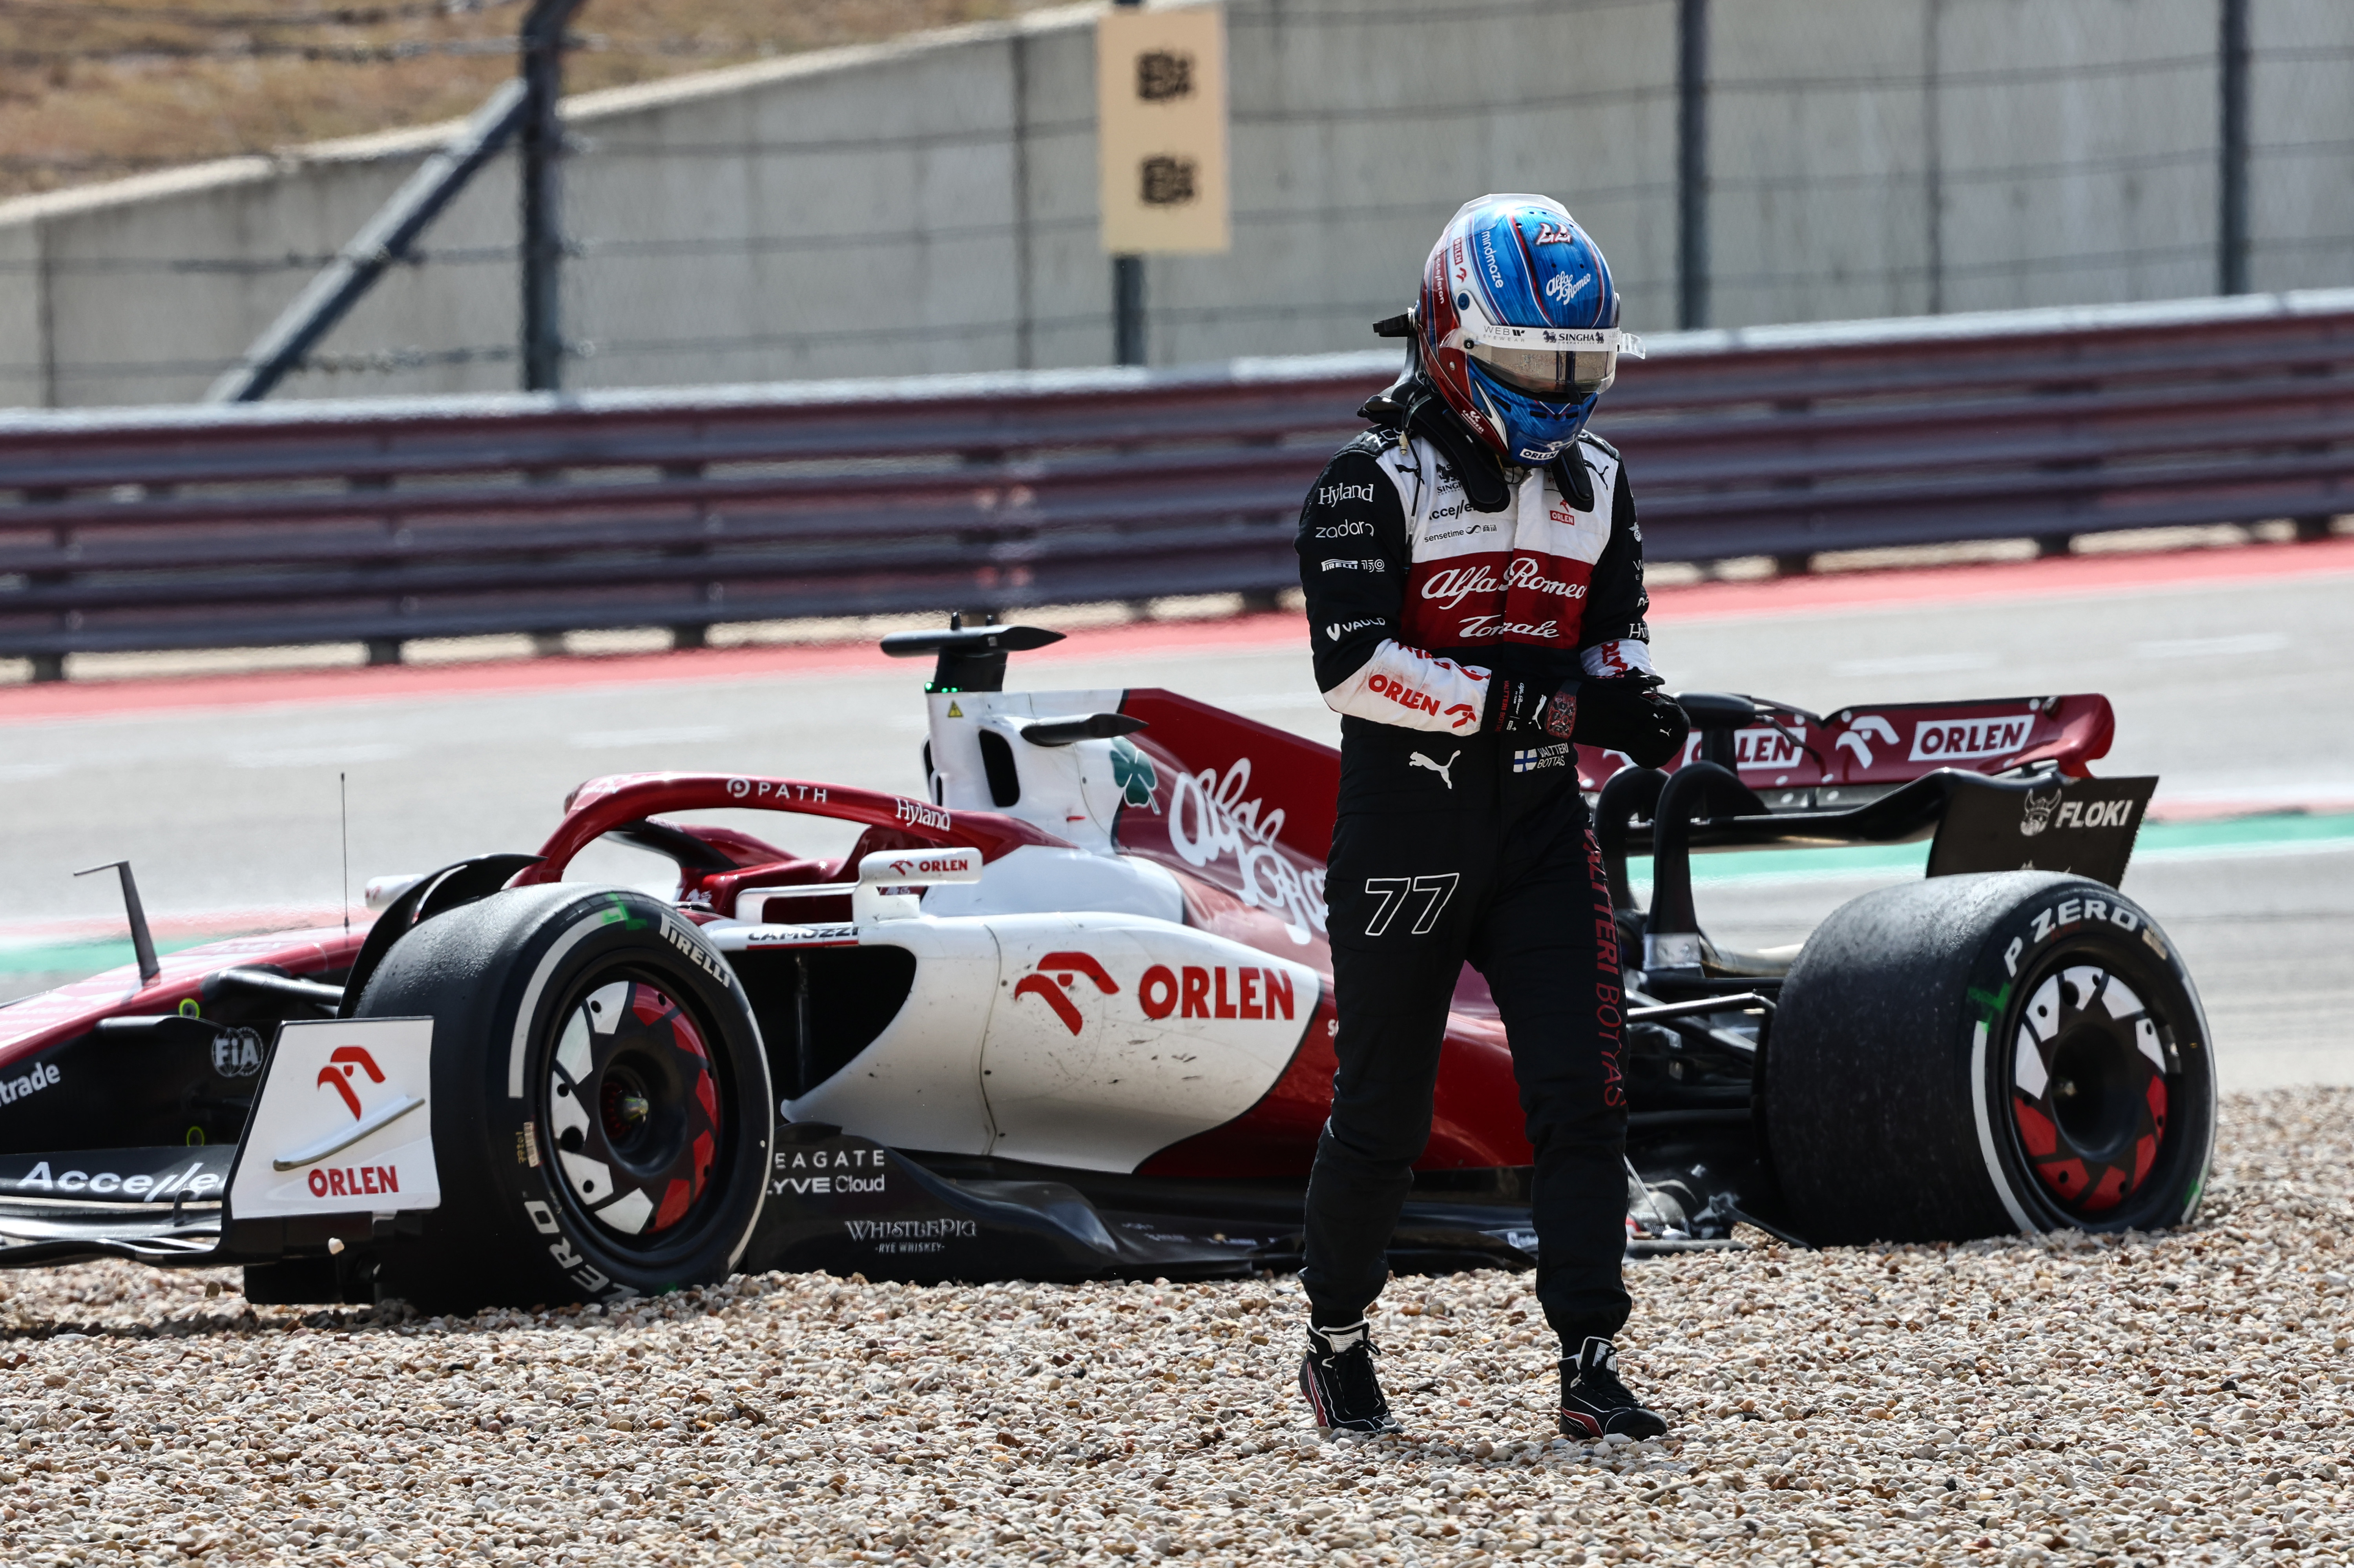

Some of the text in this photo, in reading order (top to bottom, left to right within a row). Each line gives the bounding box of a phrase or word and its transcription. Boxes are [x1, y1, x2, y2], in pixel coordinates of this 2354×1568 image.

[1482, 231, 1504, 288] mindmaze
[1546, 271, 1591, 305] Alfa Romeo
[1484, 325, 1510, 335] WEB
[1558, 333, 1595, 342] SINGHA
[1523, 451, 1556, 459] ORLEN
[1318, 483, 1374, 508] Hyland
[1429, 499, 1472, 520] ccelle
[1552, 512, 1573, 524] ORLEN
[1424, 530, 1464, 543] sensetime
[1321, 559, 1358, 572] PIRELLI
[1421, 557, 1587, 610] Alfa Romeo
[1342, 617, 1385, 632] VAULD
[1368, 674, 1441, 717] ORLEN
[1500, 680, 1509, 710] VALTTERI
[1537, 742, 1569, 758] VALTTERI
[1919, 721, 2026, 754] ORLEN
[1537, 755, 1566, 769] BOTTAS
[758, 781, 827, 803] PATH
[895, 798, 951, 831] Hyland
[2055, 800, 2133, 828] FLOKI
[919, 859, 968, 872] ORLEN
[1365, 872, 1460, 936] 77
[748, 926, 859, 941] CAMOZZI
[2004, 936, 2023, 978] P
[2031, 899, 2139, 943] ZERO
[660, 913, 732, 988] PIRELLI
[1139, 963, 1295, 1021] ORLEN
[1596, 982, 1627, 1107] BOTTAS
[0, 1062, 60, 1106] trade
[775, 1150, 885, 1169] EAGATE
[16, 1161, 225, 1202] Accelle
[308, 1165, 399, 1198] ORLEN
[835, 1174, 885, 1192] Cloud
